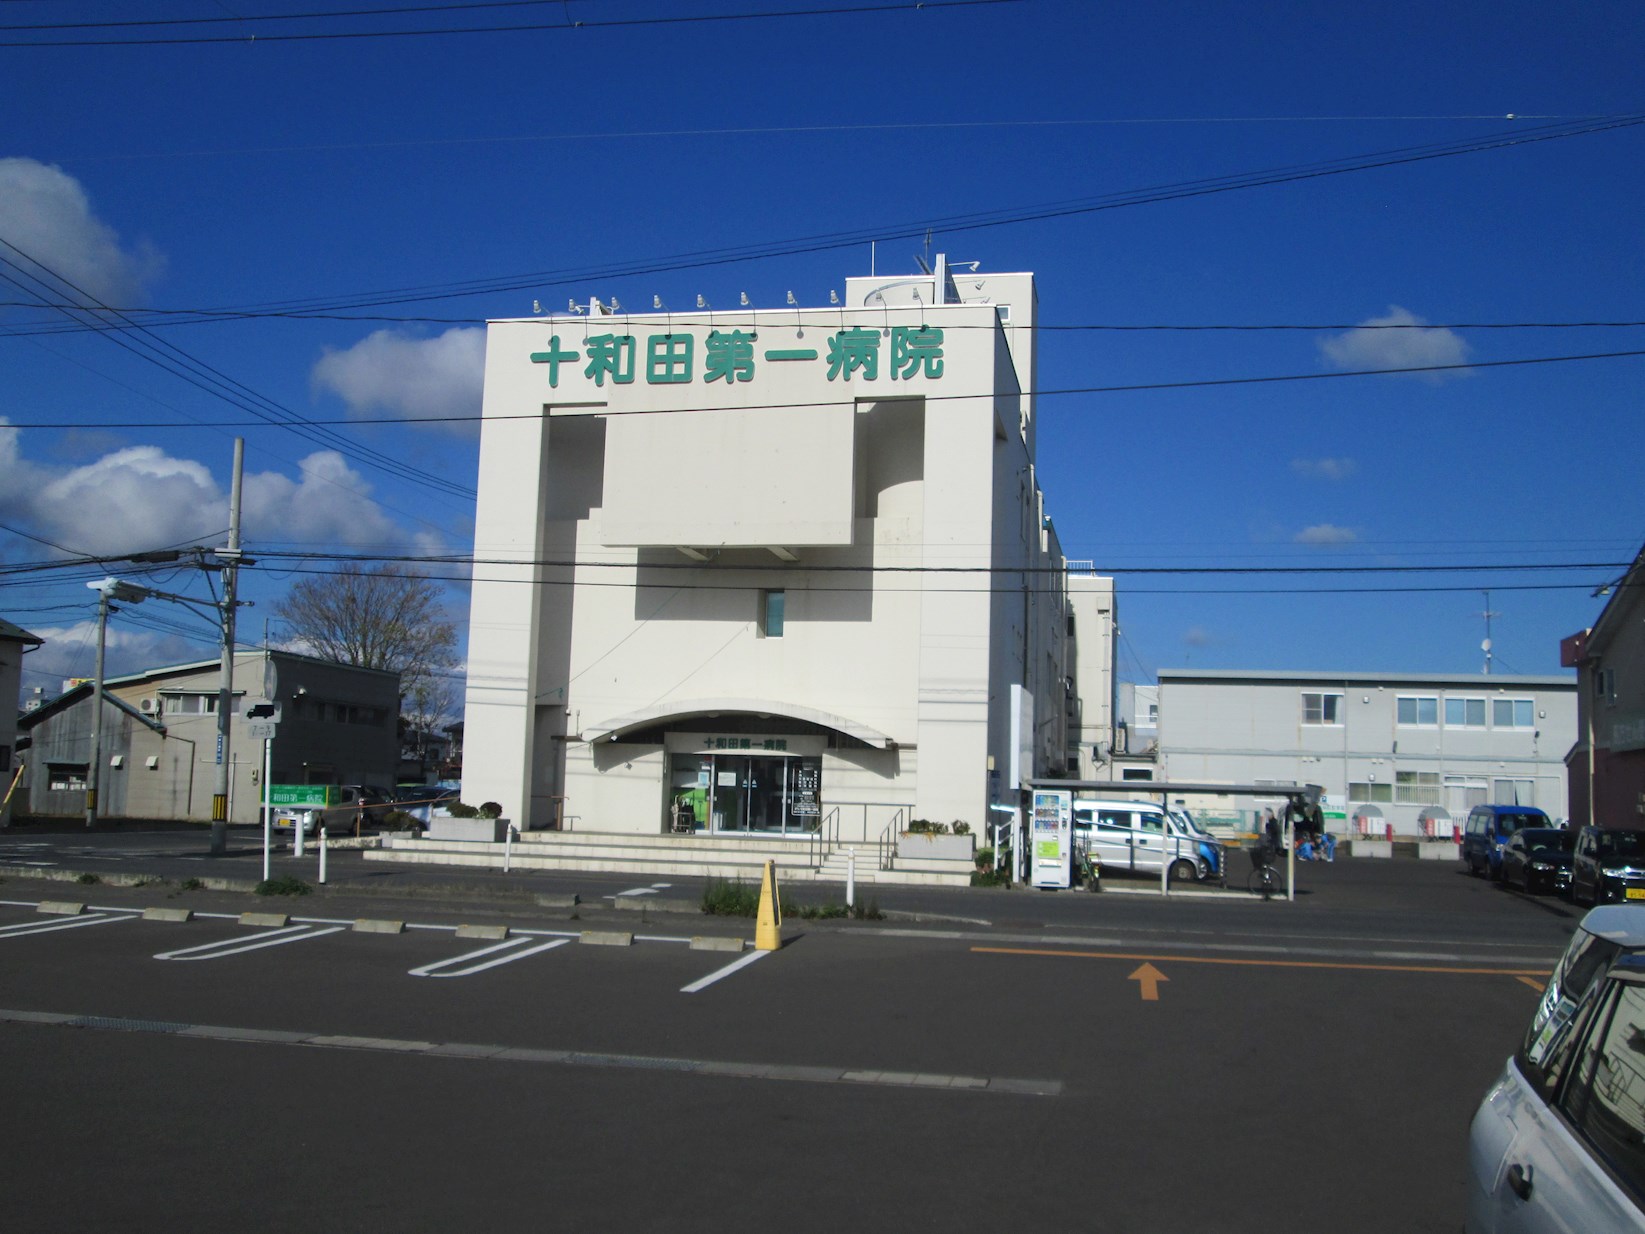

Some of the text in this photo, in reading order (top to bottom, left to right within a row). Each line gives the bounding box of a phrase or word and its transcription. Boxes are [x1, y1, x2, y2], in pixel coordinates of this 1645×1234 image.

[530, 324, 944, 387] 十和田第一病院
[704, 737, 787, 751] 十和田第一病院
[271, 793, 324, 803] 和田第一病院
